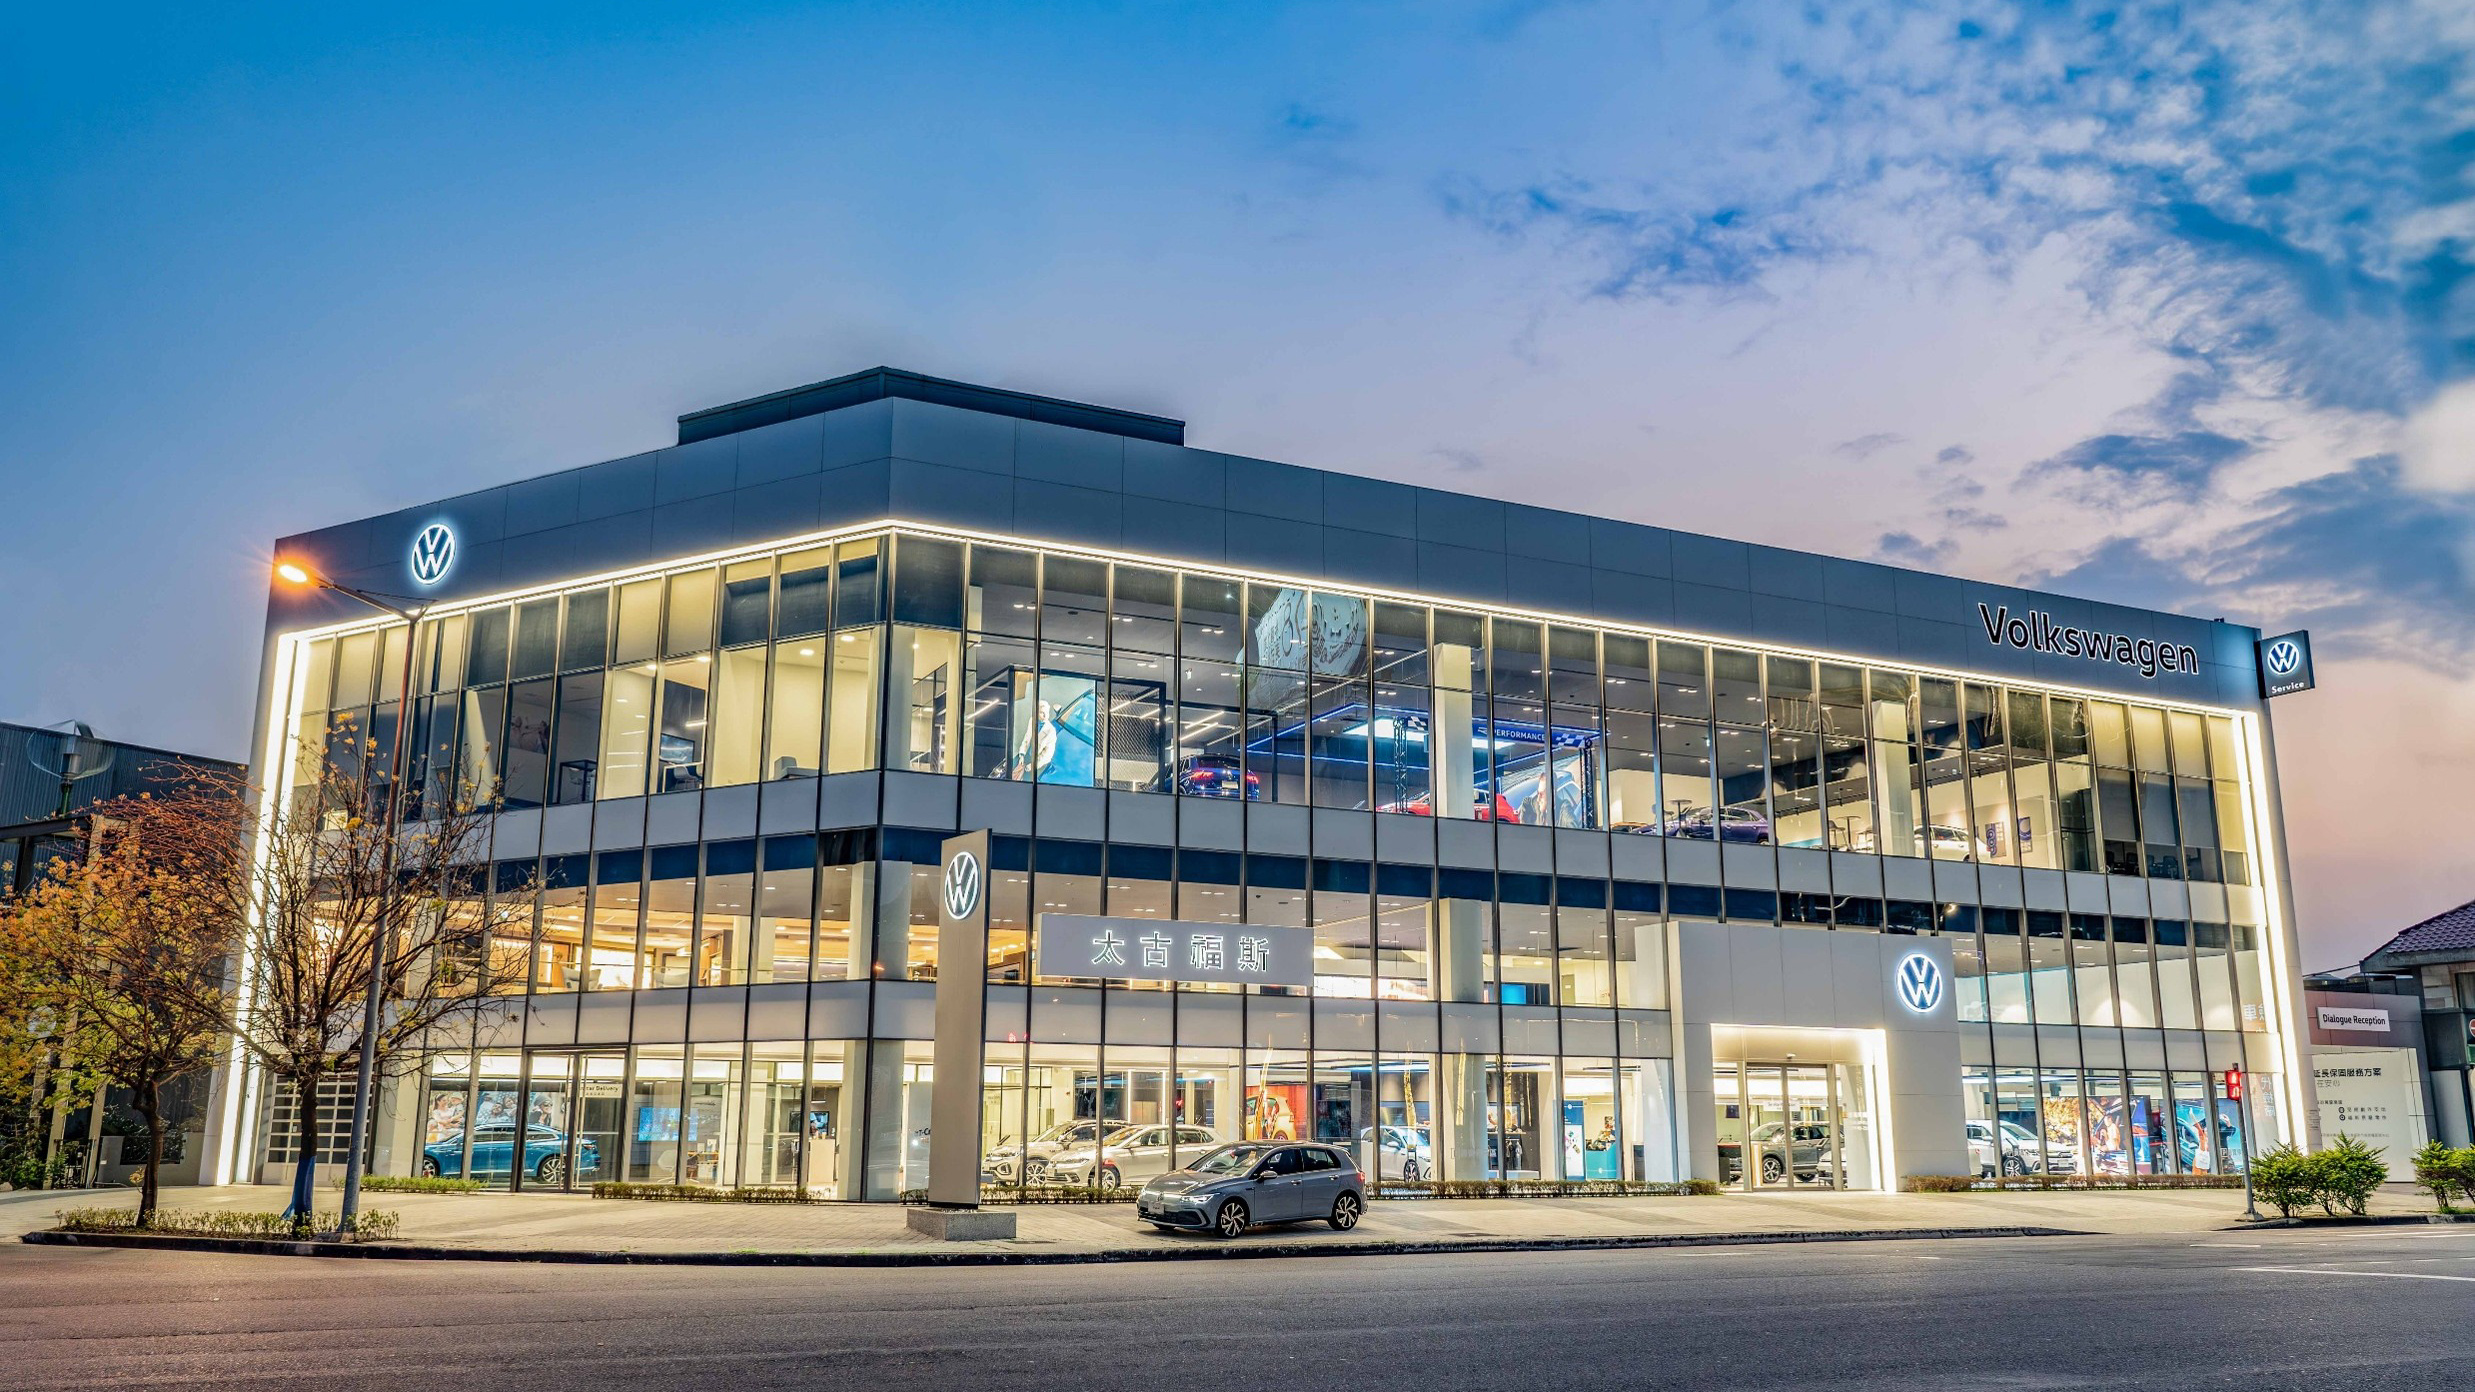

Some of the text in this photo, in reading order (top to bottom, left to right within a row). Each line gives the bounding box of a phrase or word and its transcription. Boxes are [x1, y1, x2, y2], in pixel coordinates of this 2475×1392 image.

[1978, 603, 2199, 678] Volkswagen
[2271, 682, 2304, 693] Service
[1091, 929, 1270, 972] 太古福斯
[2322, 1013, 2386, 1026] Dialogue Reception
